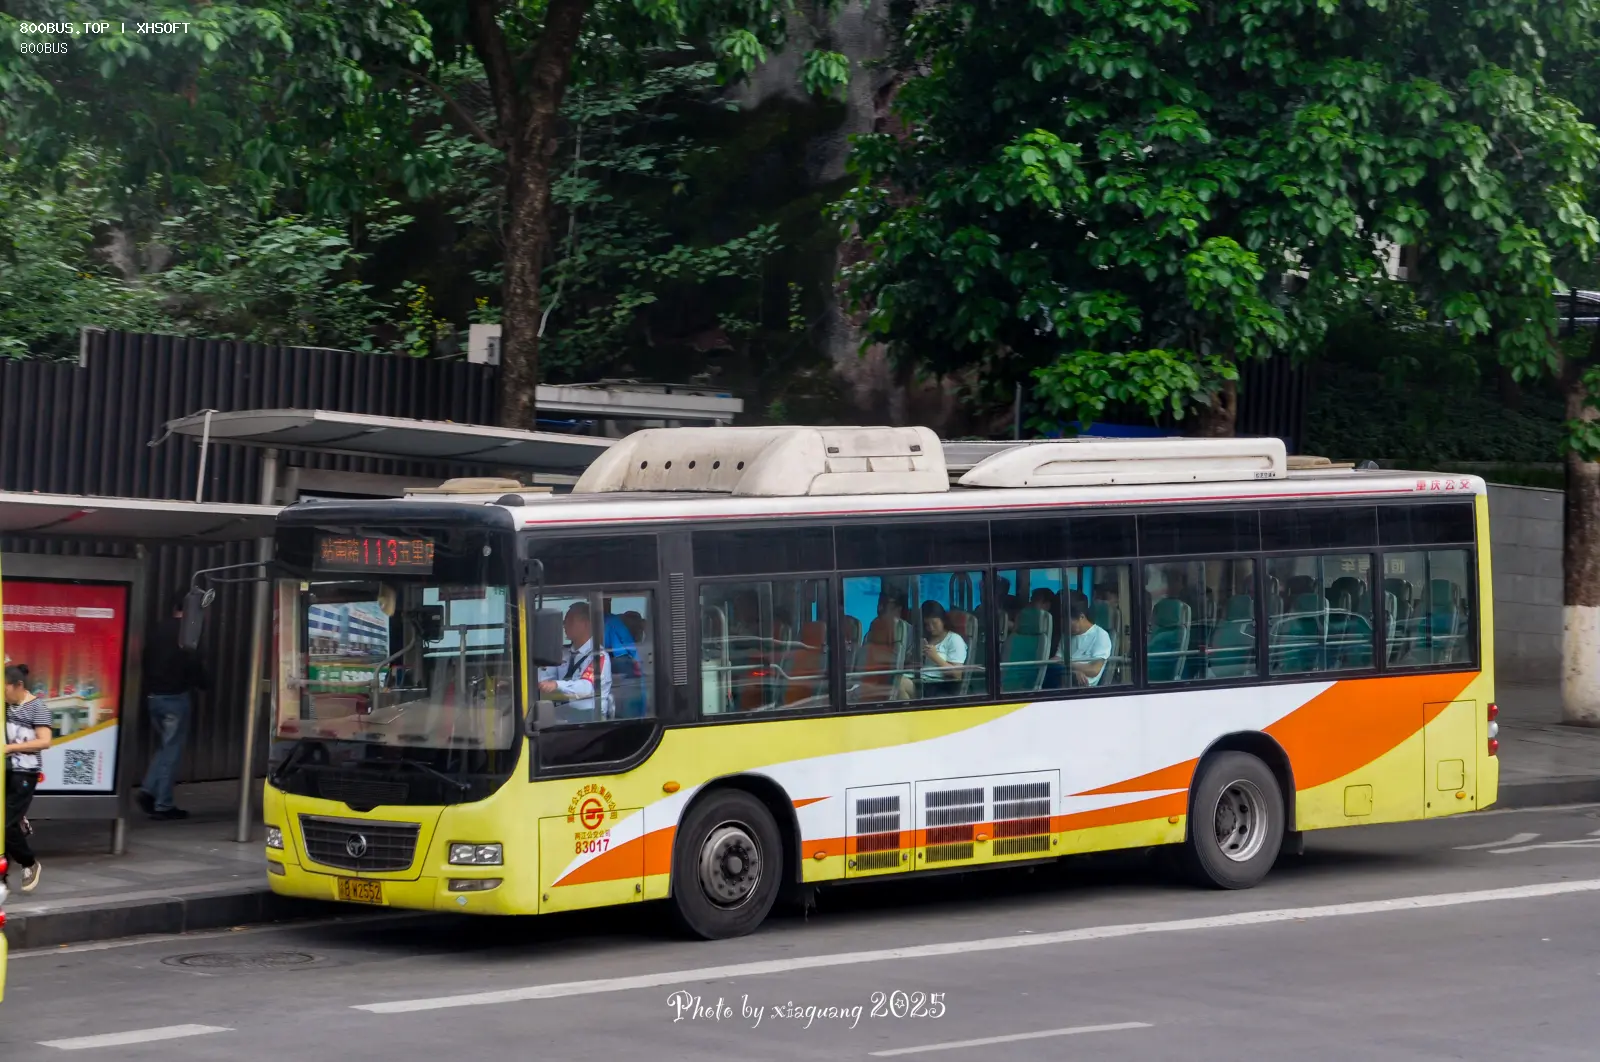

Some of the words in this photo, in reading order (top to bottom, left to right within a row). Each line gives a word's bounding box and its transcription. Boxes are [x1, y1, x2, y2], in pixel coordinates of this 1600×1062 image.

[1416, 480, 1470, 491] 重庆公交
[362, 538, 397, 566] 113
[575, 838, 610, 854] 83017
